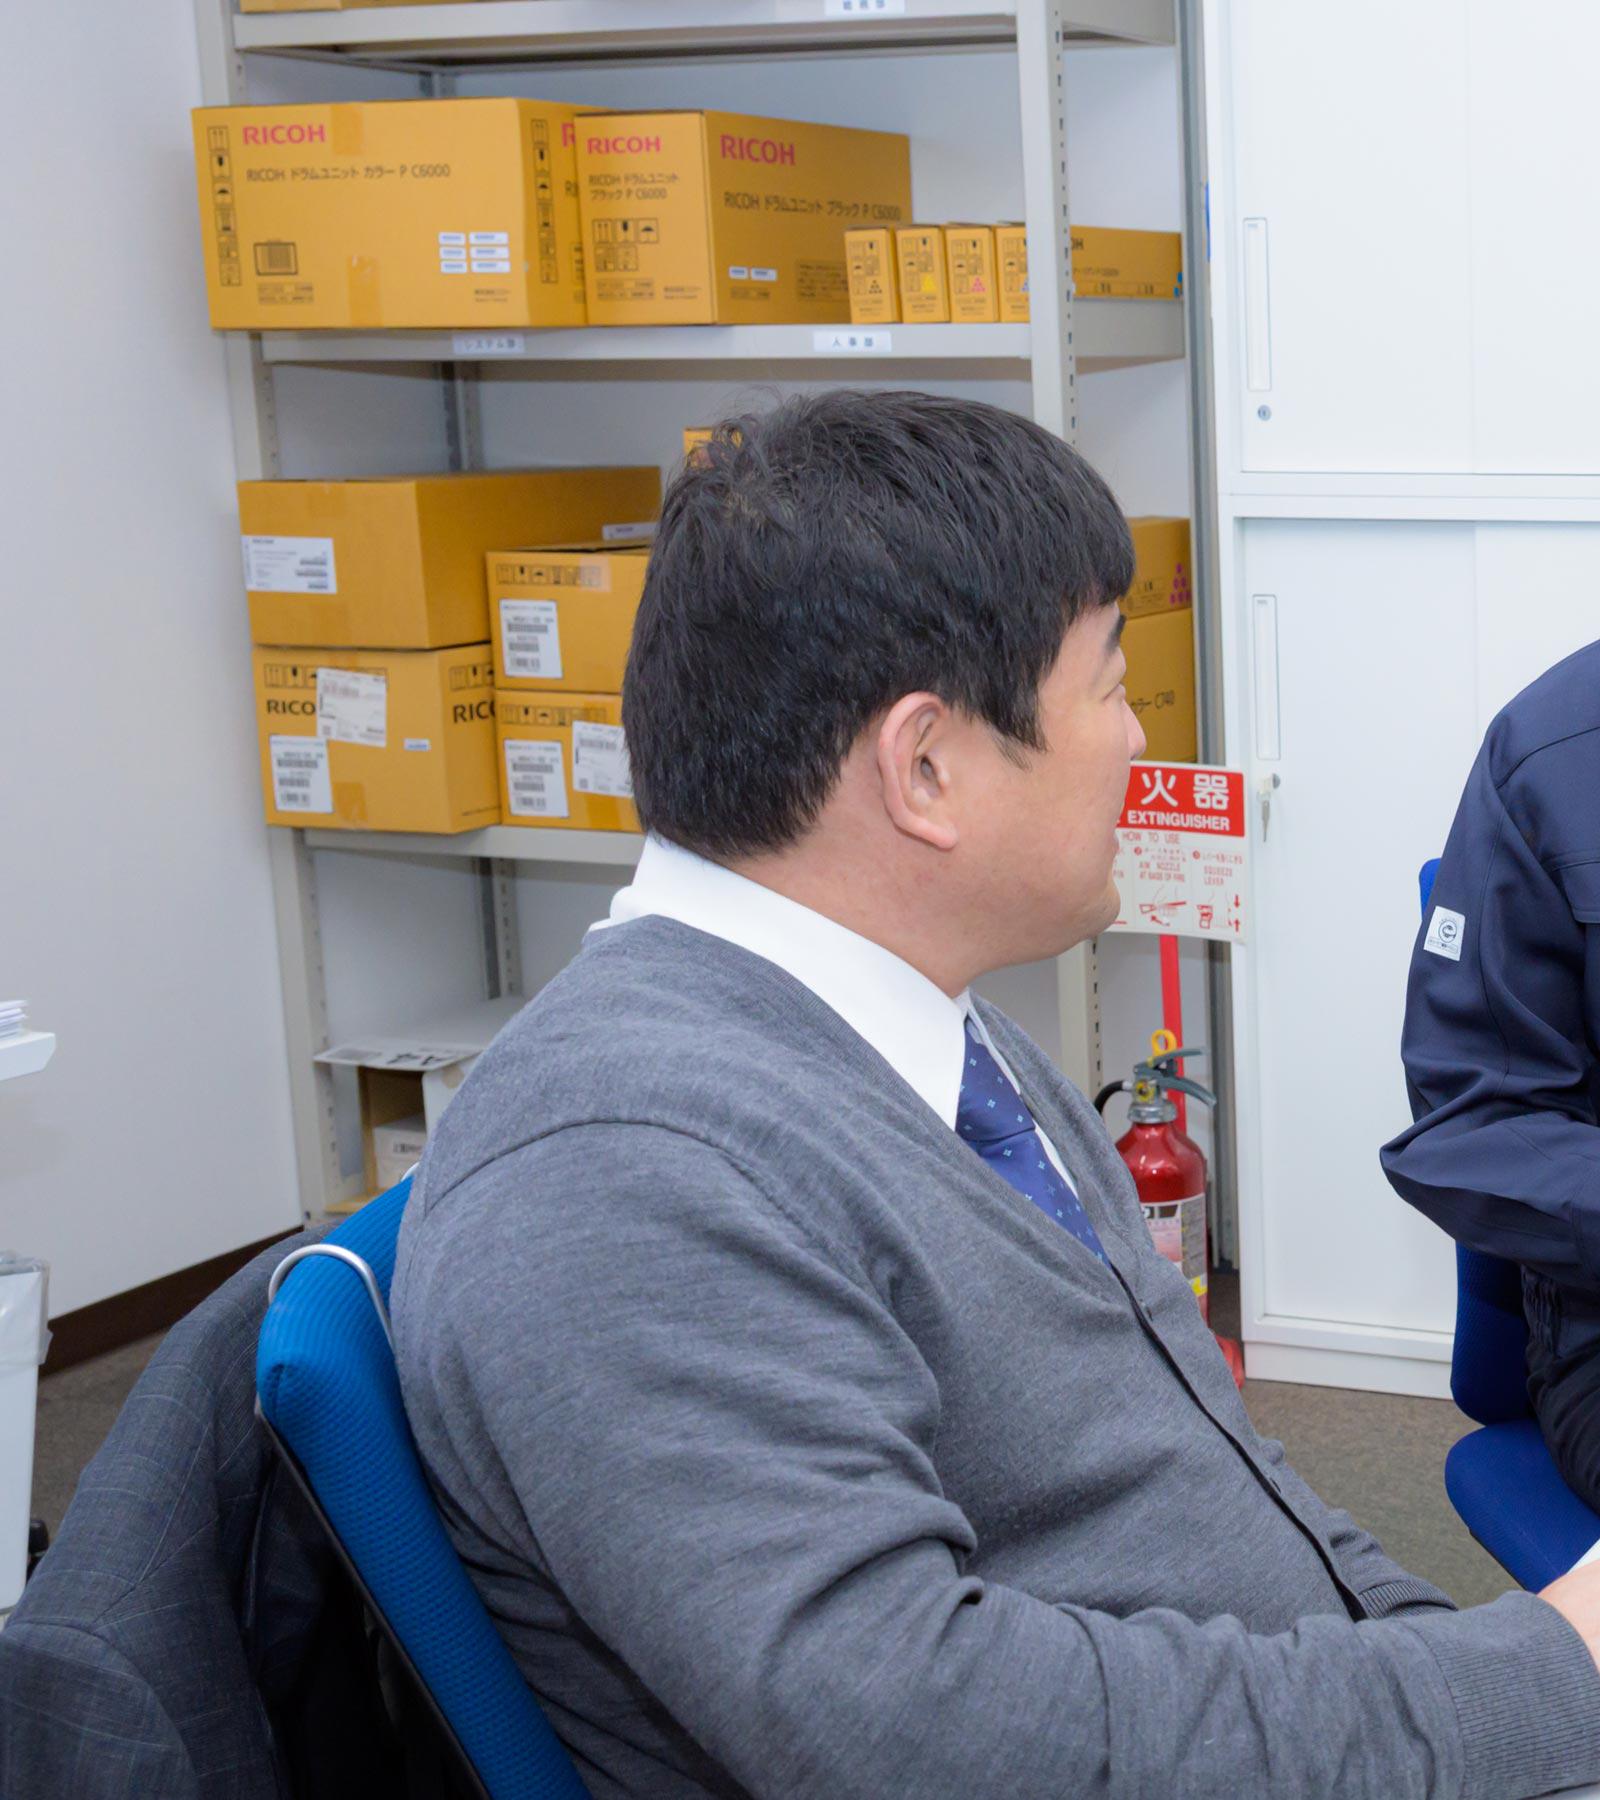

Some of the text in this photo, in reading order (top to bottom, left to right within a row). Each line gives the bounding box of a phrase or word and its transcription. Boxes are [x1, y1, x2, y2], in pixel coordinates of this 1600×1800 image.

[242, 124, 325, 146] RICOH
[587, 136, 661, 154] RICOH
[720, 134, 796, 166] RICOH
[246, 167, 285, 181] RICOH
[724, 191, 760, 210] RICOH
[266, 699, 316, 716] RICO
[453, 700, 496, 723] RIC
[1140, 769, 1230, 810] 火器
[1127, 810, 1230, 831] EXTINGUISHER
[1122, 831, 1181, 844] HOW TO USE
